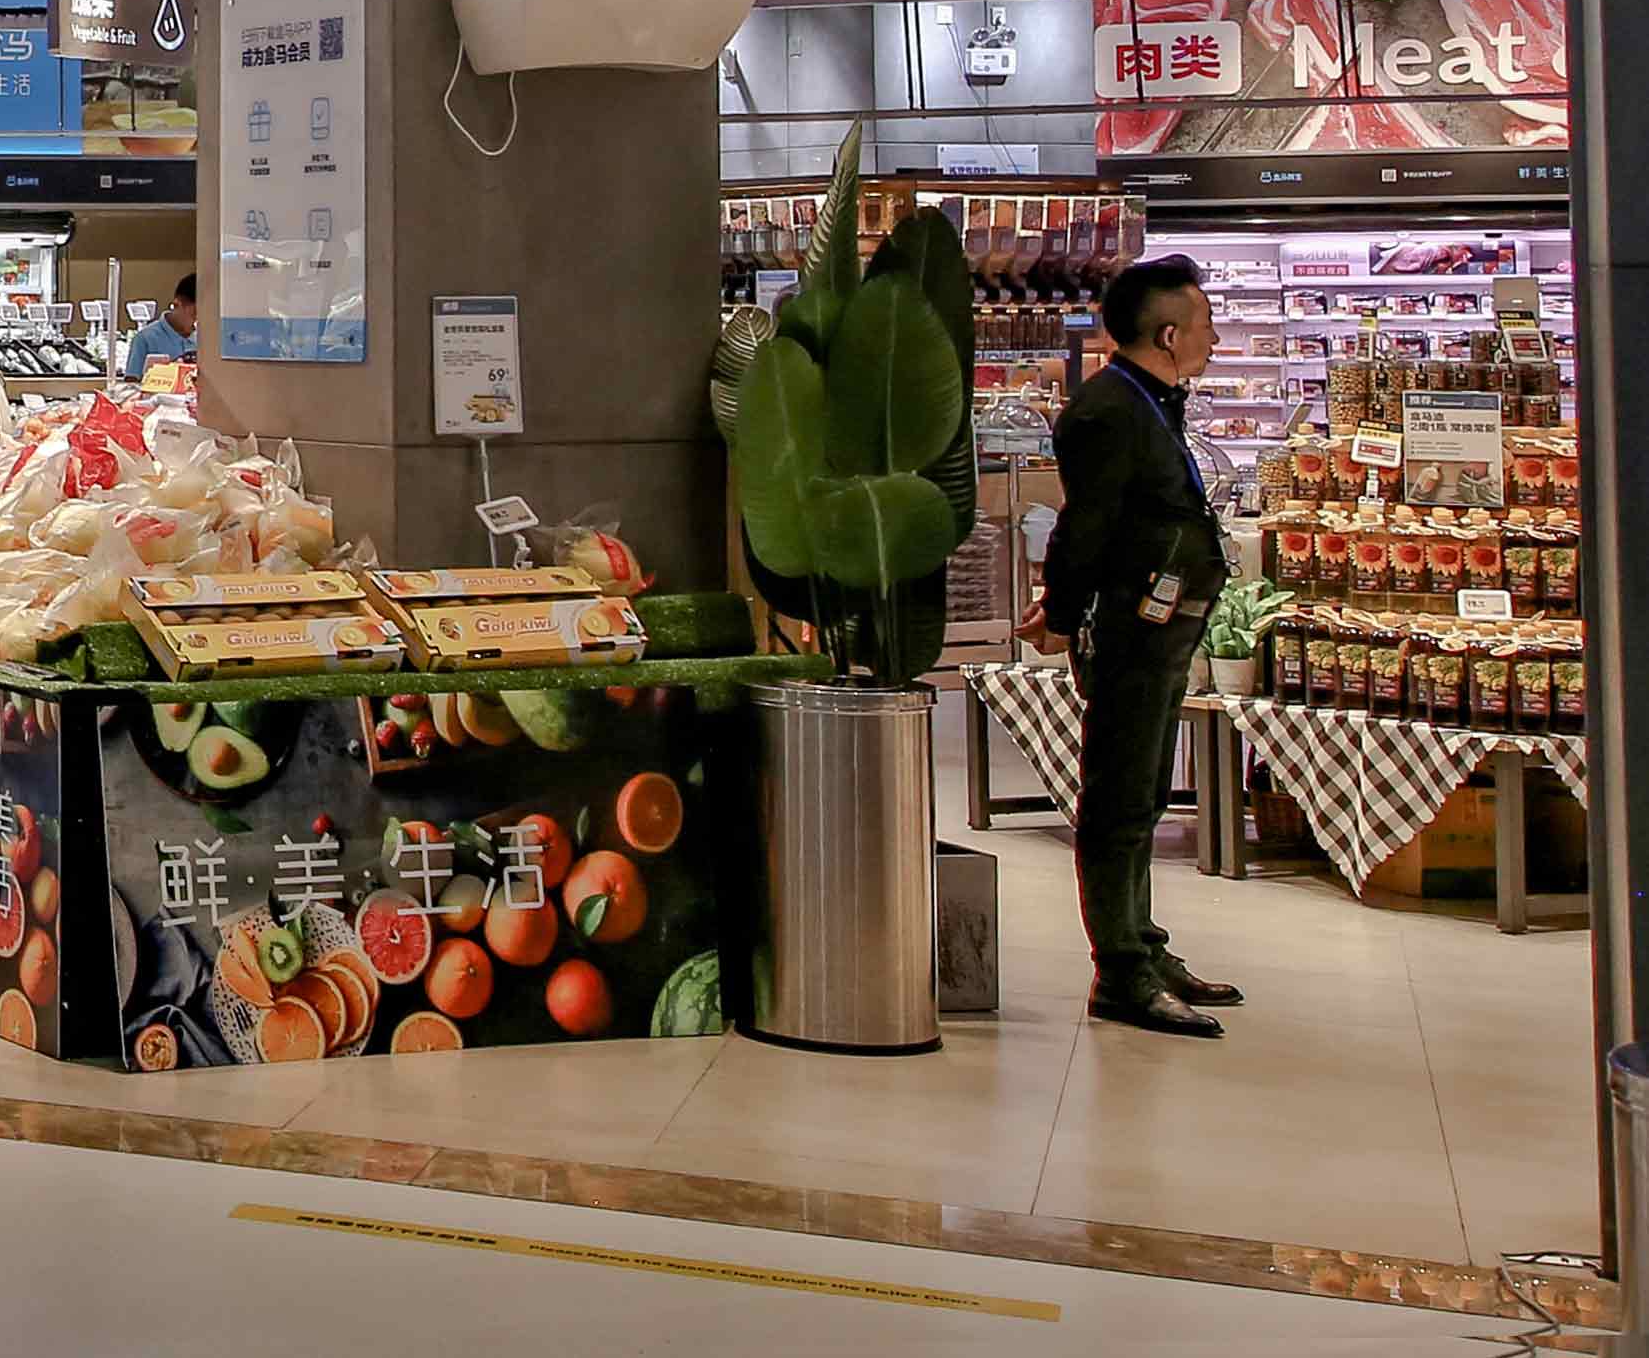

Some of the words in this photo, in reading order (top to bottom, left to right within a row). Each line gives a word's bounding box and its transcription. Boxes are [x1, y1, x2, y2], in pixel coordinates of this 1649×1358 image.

[70, 23, 109, 43] Vegetable
[117, 28, 137, 46] Fruit
[242, 42, 310, 68] 成为盒马会员
[1115, 35, 1222, 84] 肉类
[1293, 21, 1529, 89] Meat
[475, 616, 515, 635] Gold
[520, 615, 552, 632] kiwi
[226, 630, 270, 647] Gold
[273, 628, 308, 645] kiwi
